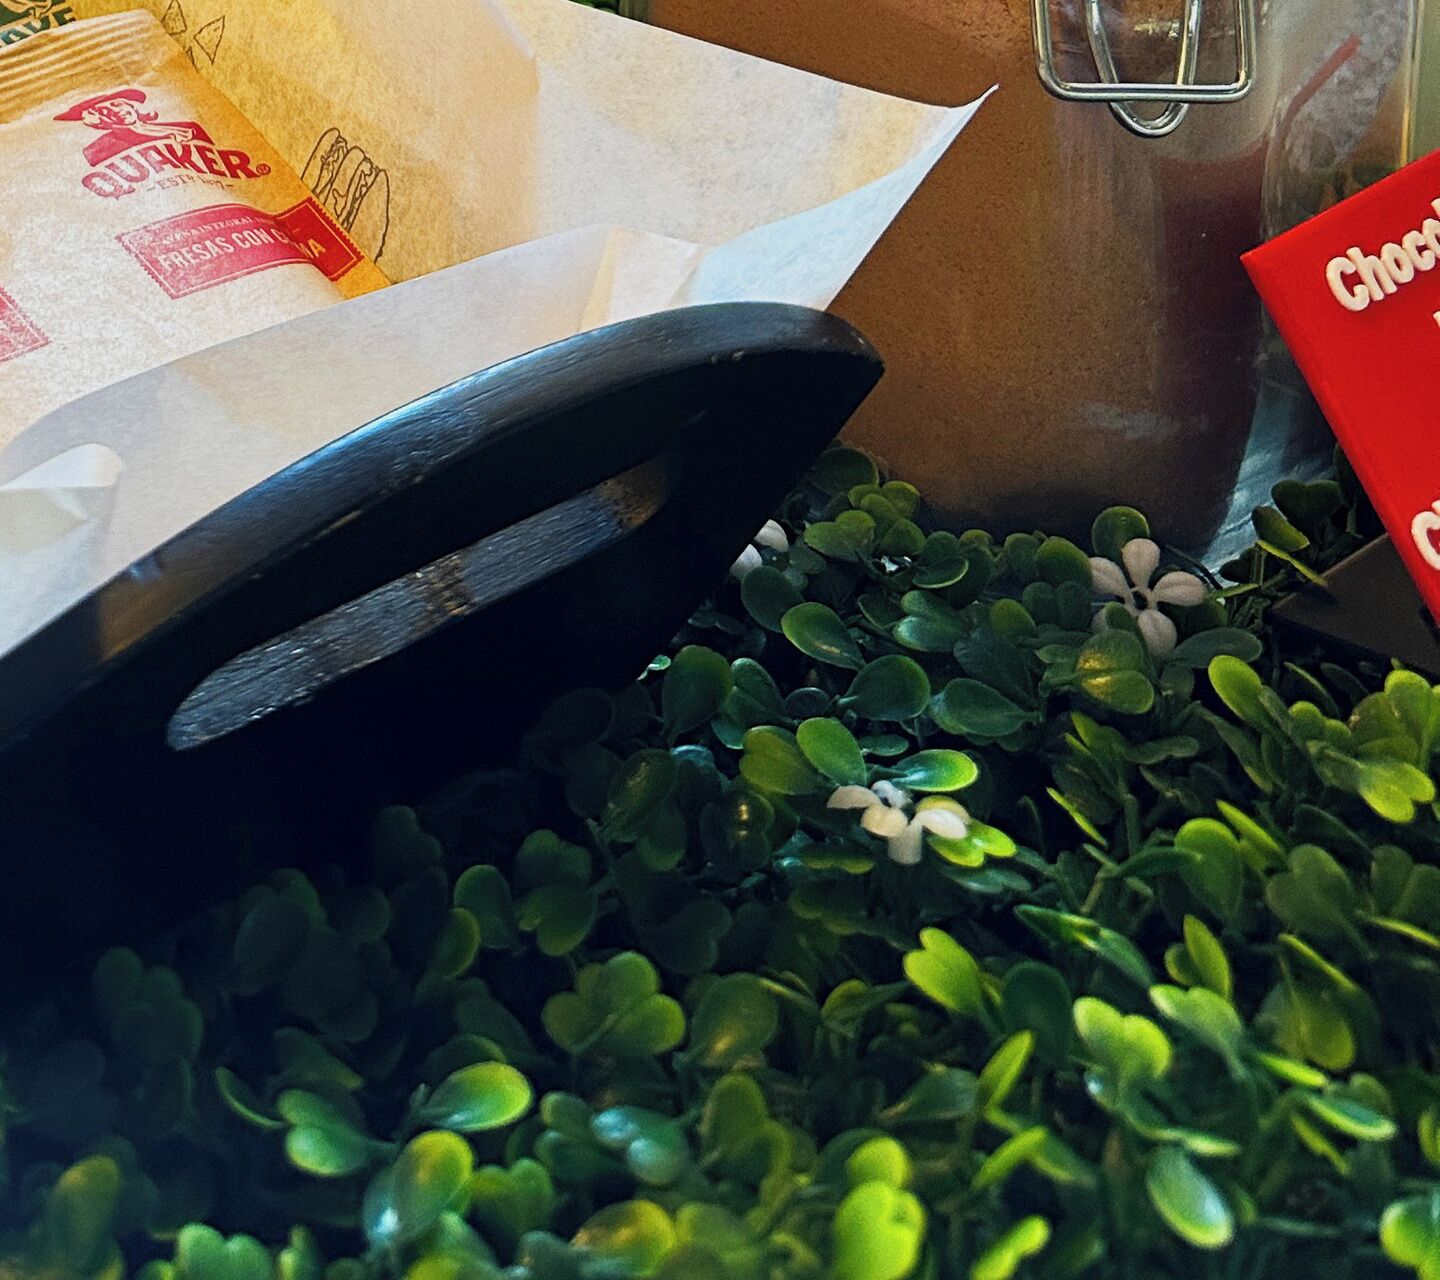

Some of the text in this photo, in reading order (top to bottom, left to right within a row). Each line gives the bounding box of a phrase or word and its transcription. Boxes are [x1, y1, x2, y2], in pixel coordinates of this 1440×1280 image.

[81, 143, 262, 201] QUAKER
[158, 237, 235, 272] FRESAS
[231, 227, 275, 249] CON
